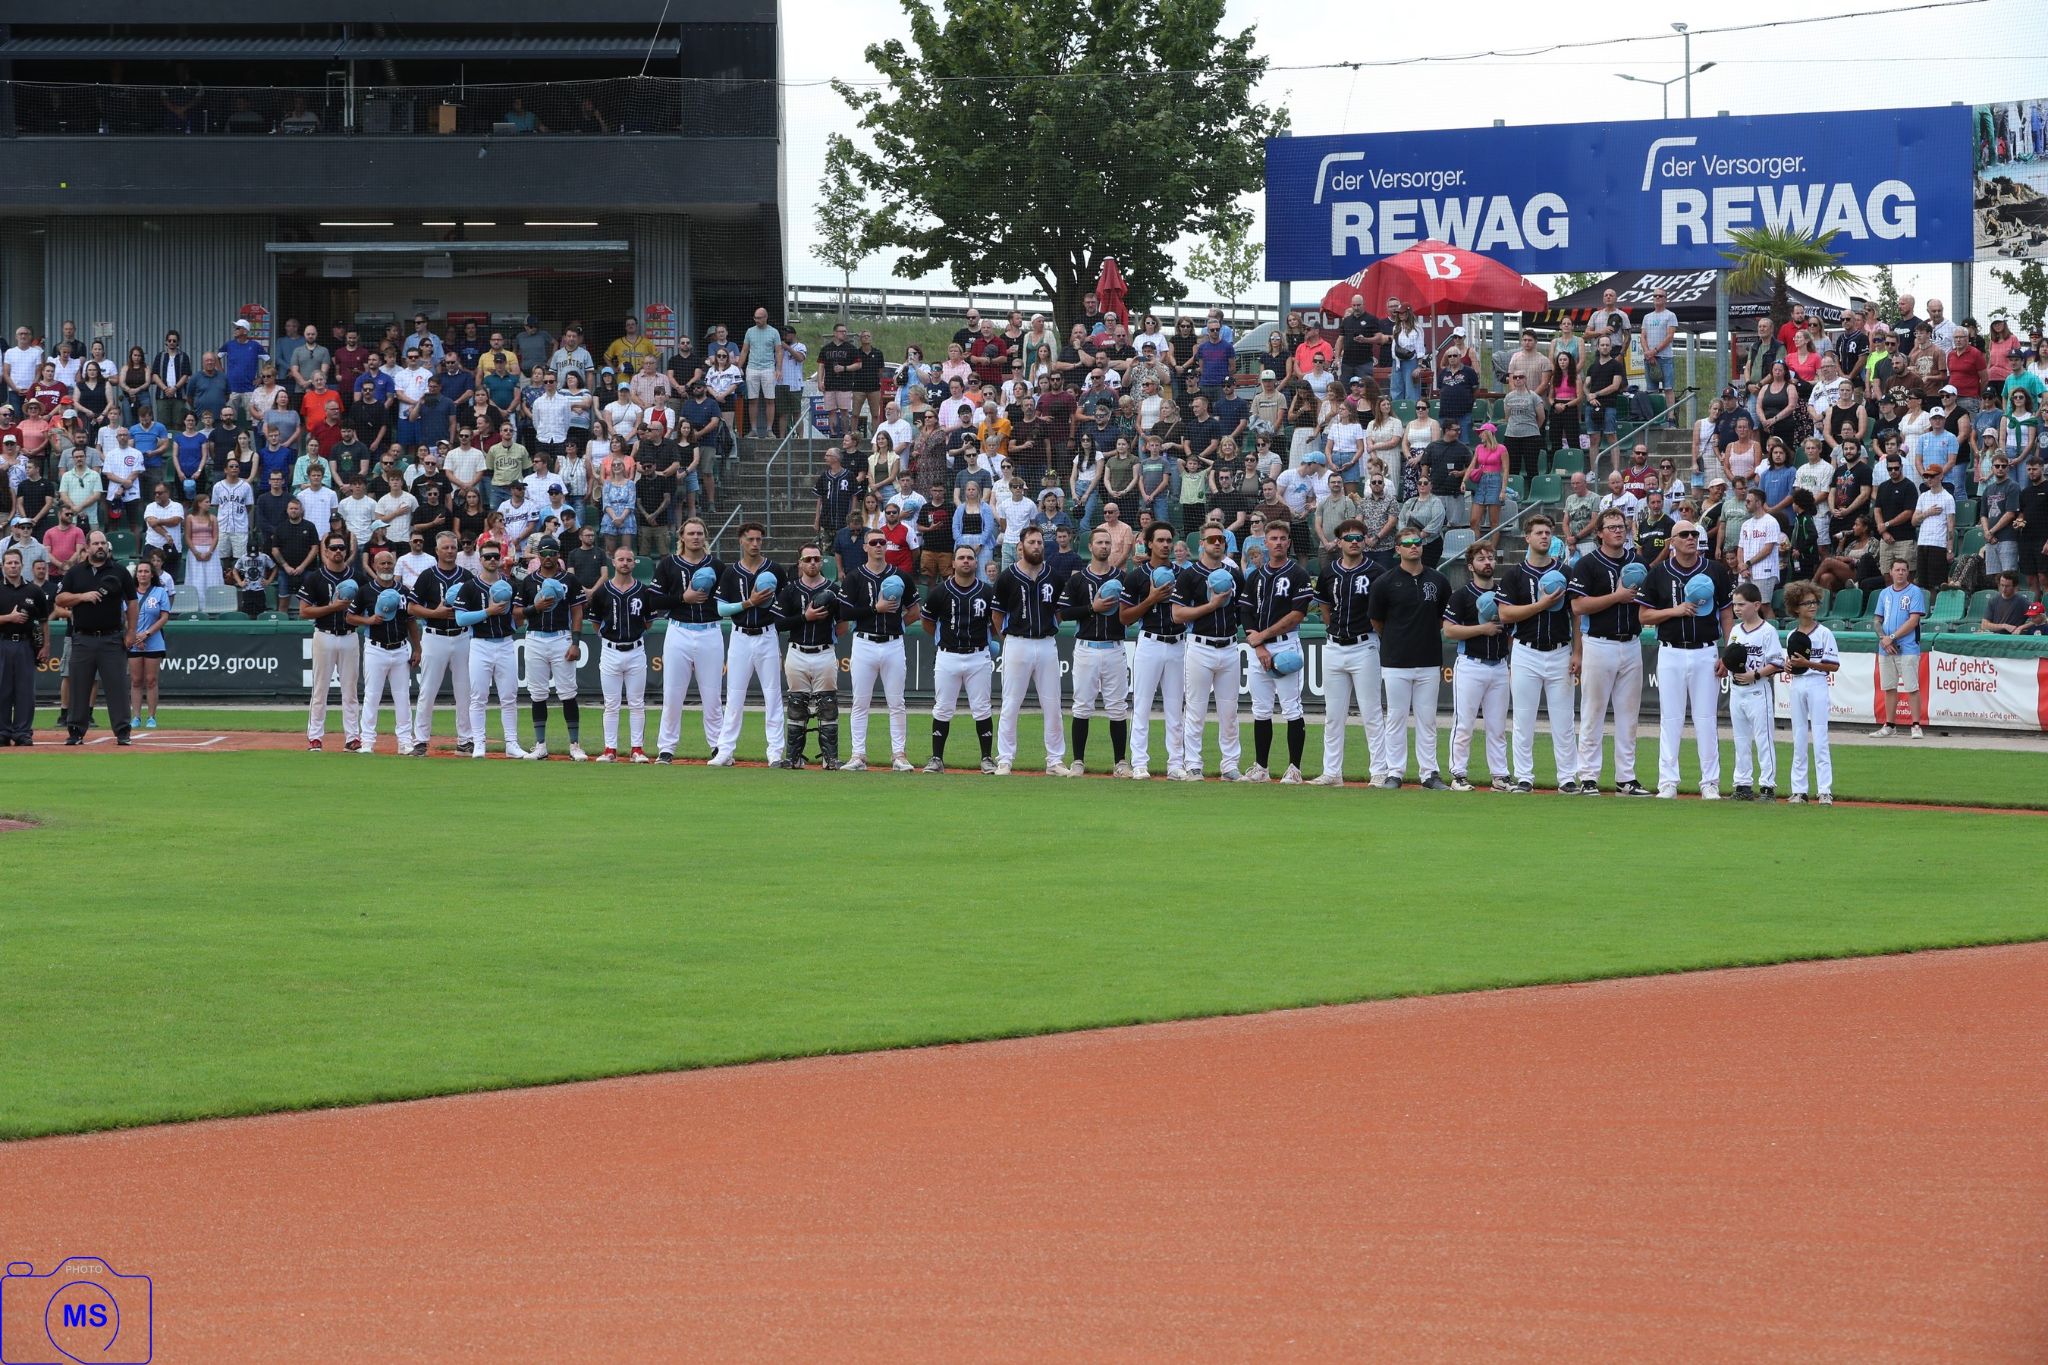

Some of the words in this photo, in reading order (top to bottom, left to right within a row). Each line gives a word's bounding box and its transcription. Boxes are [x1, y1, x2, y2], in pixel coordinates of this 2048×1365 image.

[1661, 156, 1696, 178] der
[1702, 154, 1806, 179] Versorger.
[1332, 170, 1364, 191] der
[1369, 168, 1467, 192] Versorger.
[1661, 179, 1917, 245] REWAG
[1332, 192, 1569, 257] REWAG
[1422, 252, 1462, 280] B
[1632, 272, 1701, 290] RUFF
[1653, 538, 1664, 547] 69
[1041, 583, 1053, 602] R
[1275, 577, 1290, 597] R
[1355, 575, 1370, 594] R
[630, 598, 643, 616] R
[972, 598, 987, 617] R
[160, 653, 278, 674] w.p29.group
[1937, 657, 1957, 672] Auf
[1960, 658, 1998, 676] geht's,
[1937, 676, 1997, 693] Legionäre!
